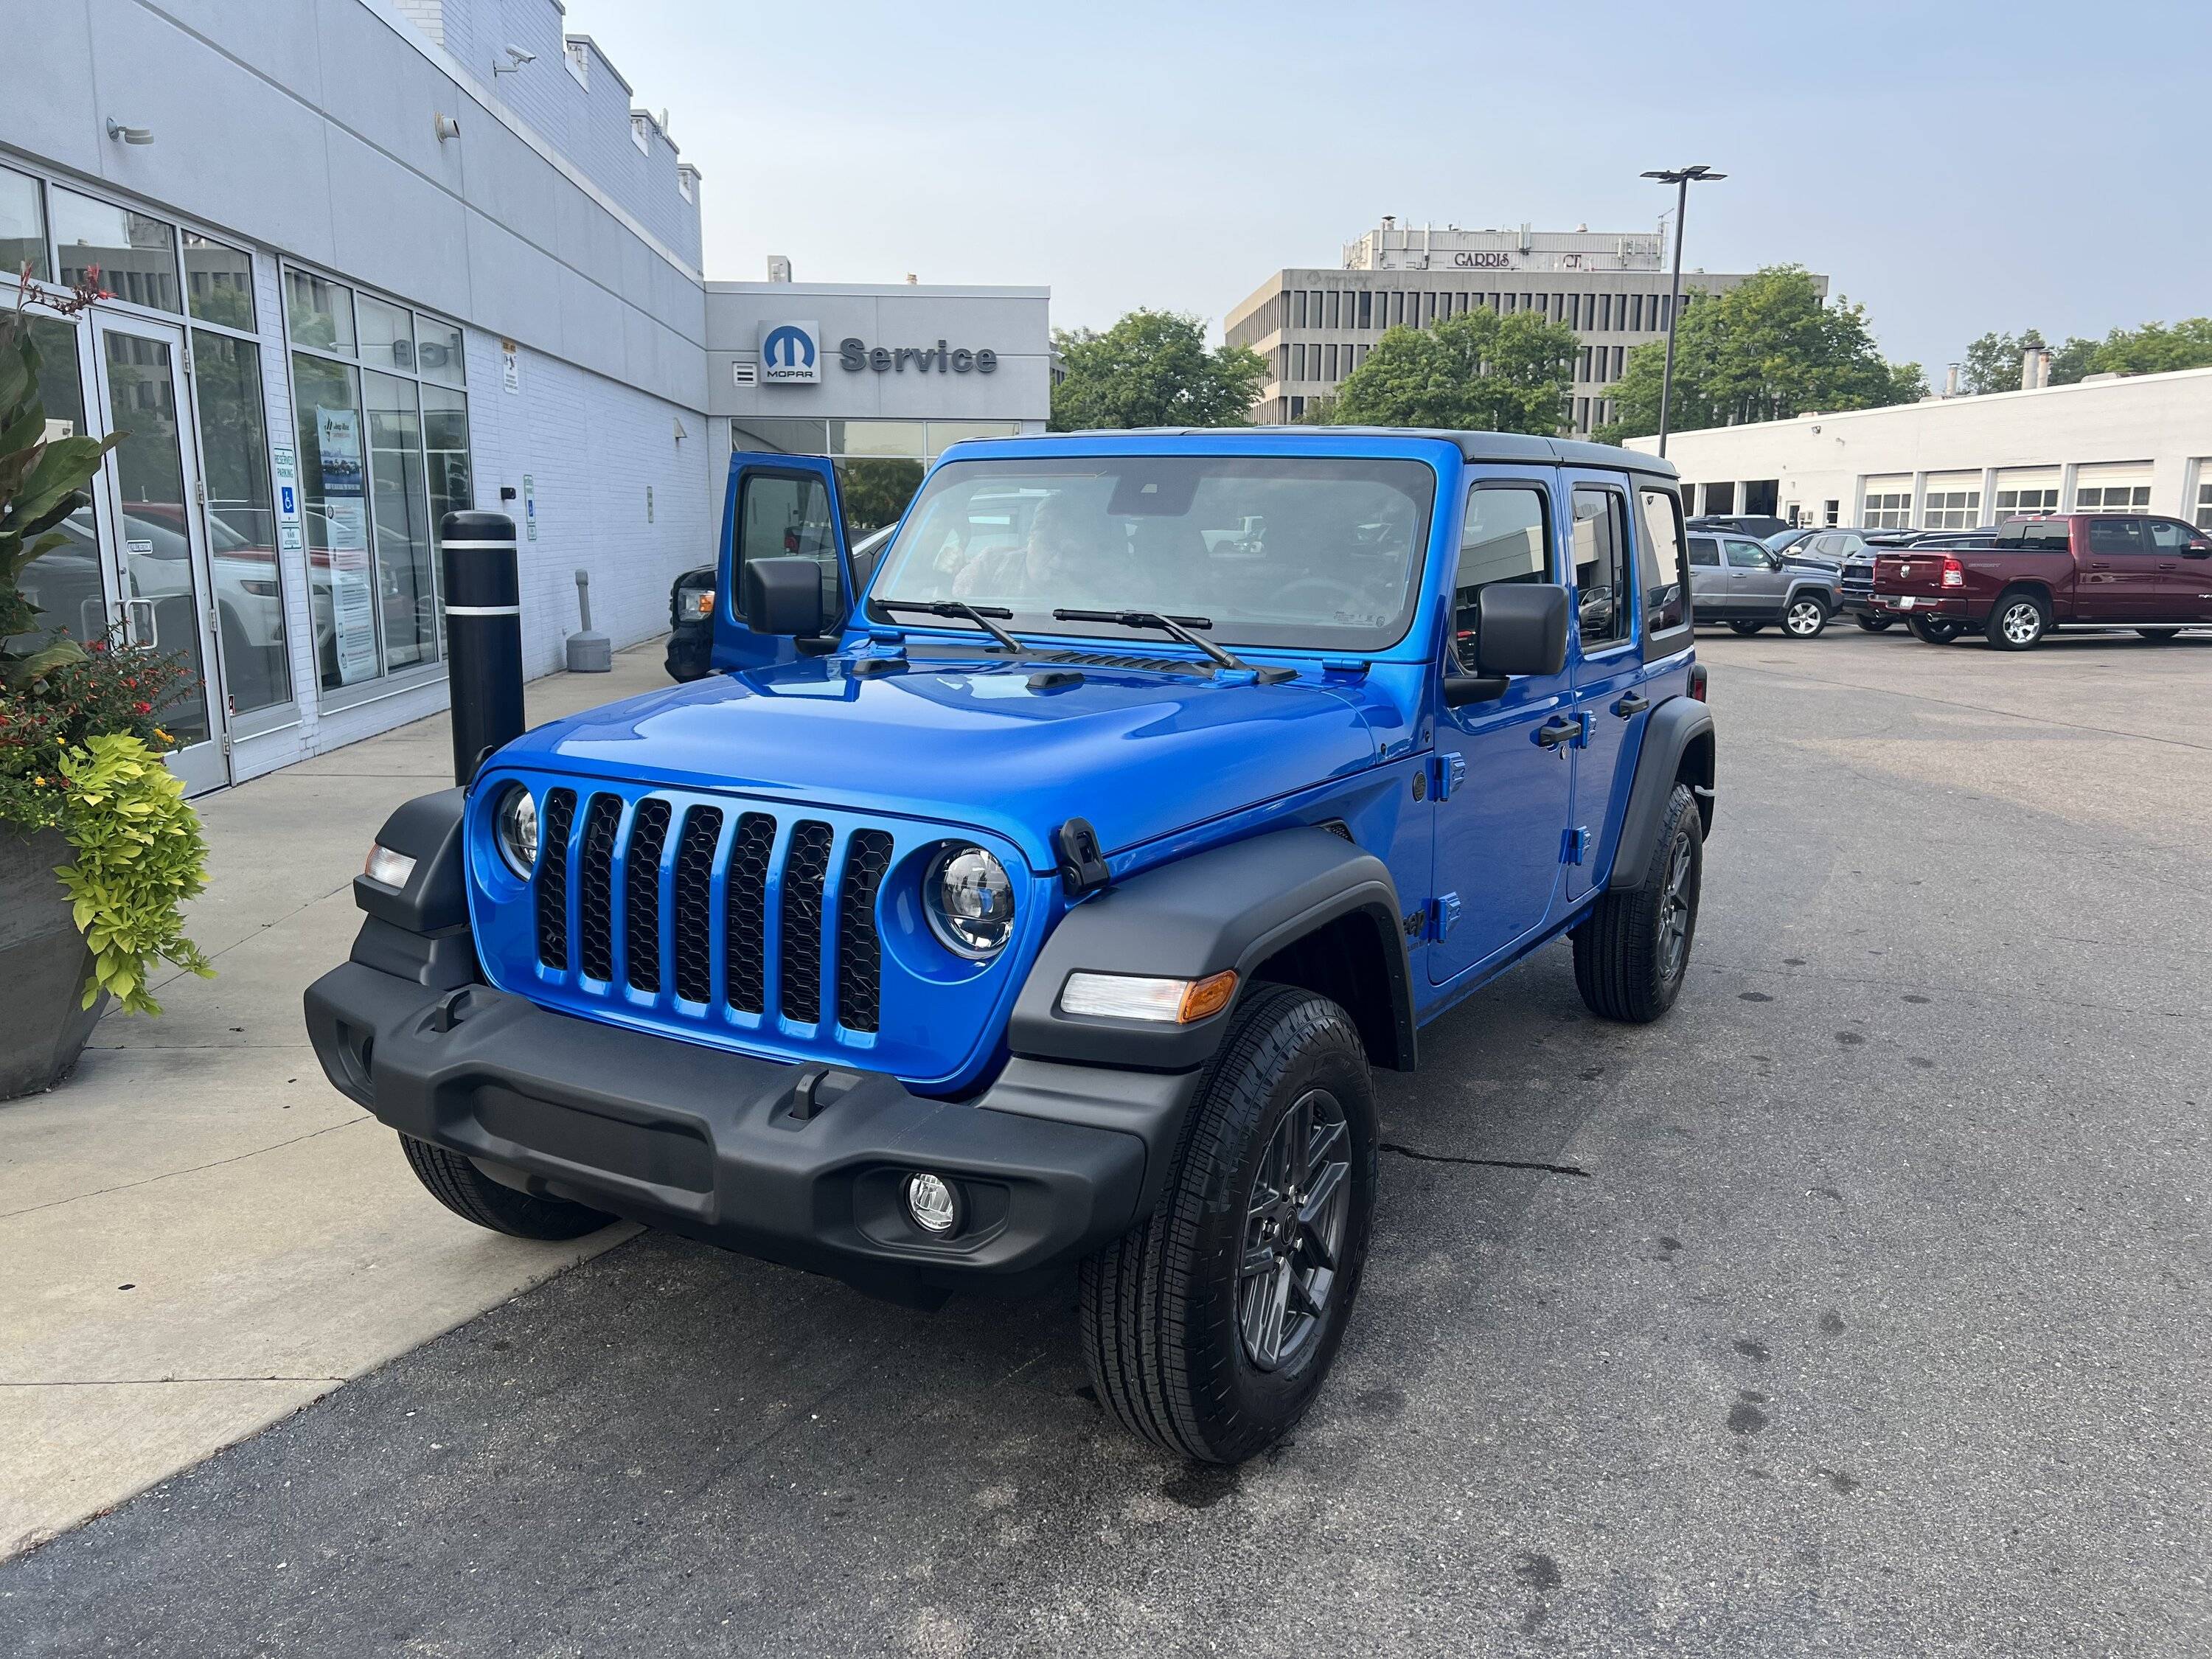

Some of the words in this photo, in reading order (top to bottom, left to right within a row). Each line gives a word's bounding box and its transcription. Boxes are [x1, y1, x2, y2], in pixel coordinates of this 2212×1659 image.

[839, 338, 997, 372] Service
[767, 370, 813, 378] MOPAR
[274, 454, 294, 465] RESERVED
[276, 467, 293, 478] PARKING
